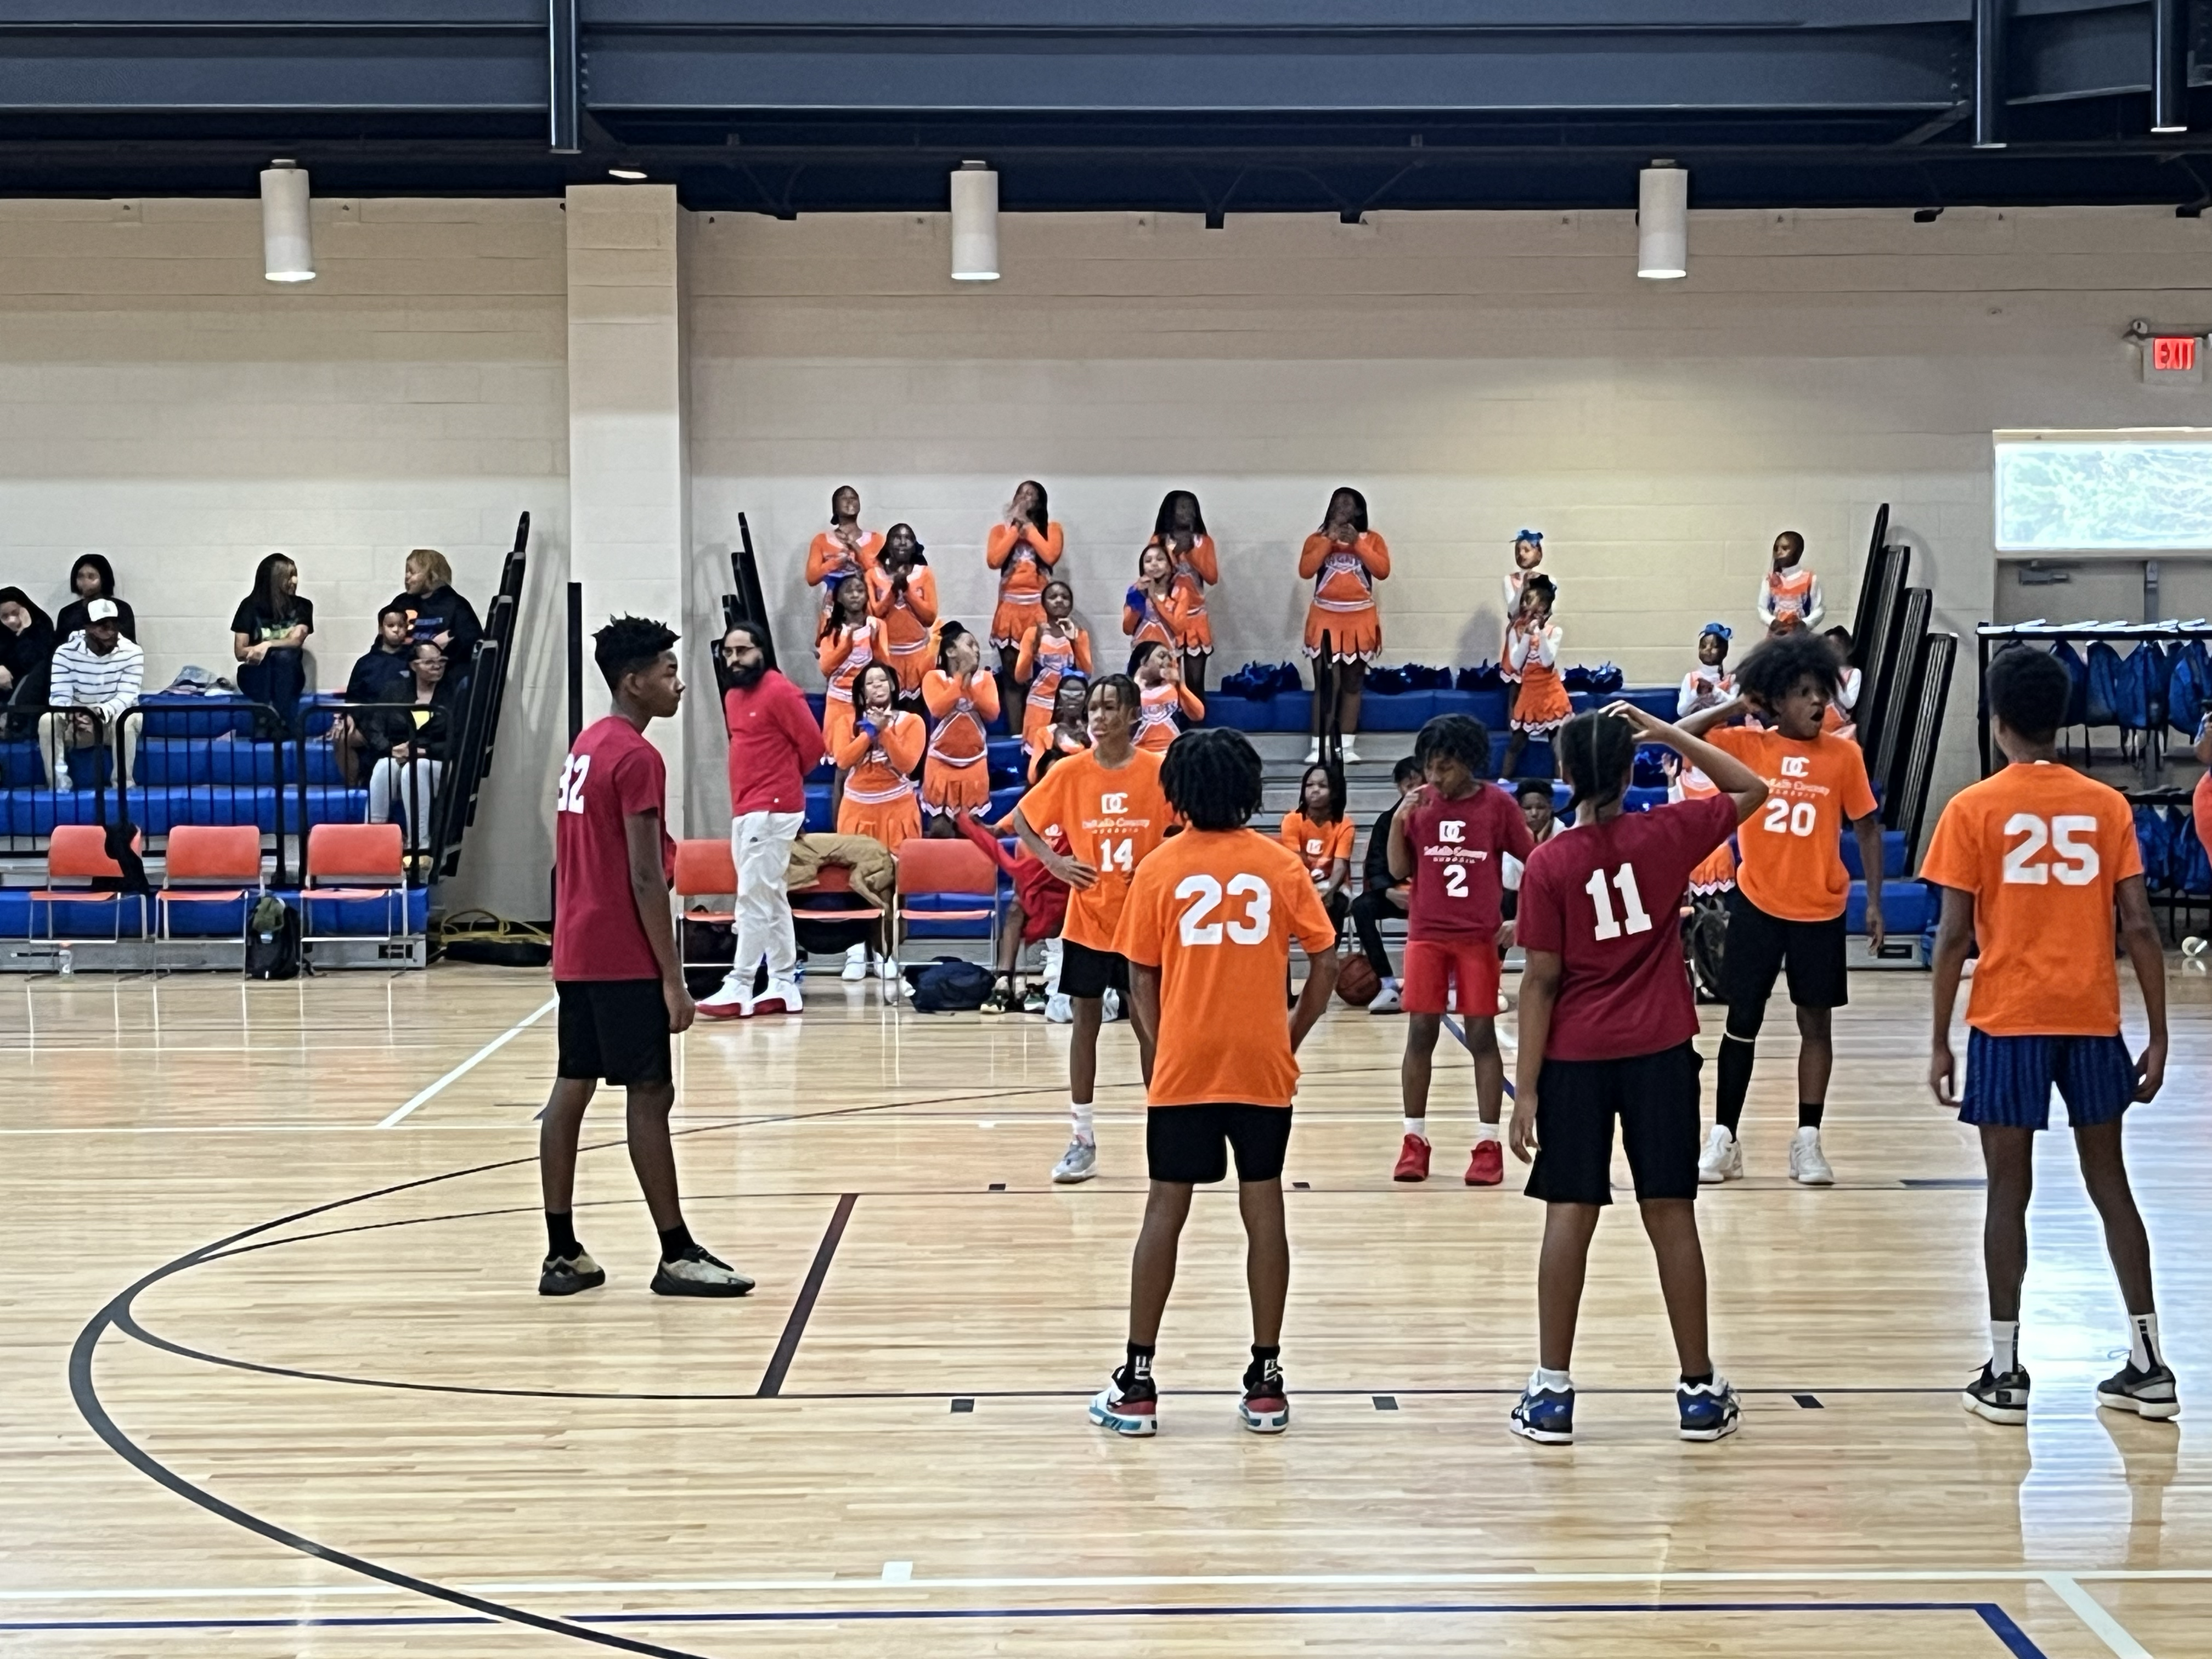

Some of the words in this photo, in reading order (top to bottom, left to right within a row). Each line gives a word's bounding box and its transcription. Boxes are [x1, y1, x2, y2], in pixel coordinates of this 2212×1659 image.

[2154, 338, 2194, 370] EXIT
[1764, 798, 1816, 837] 20
[1100, 838, 1133, 872] 14
[2004, 813, 2099, 886] 25
[1443, 864, 1469, 898] 2
[1175, 873, 1272, 947] 23
[1585, 862, 1652, 941] 11
